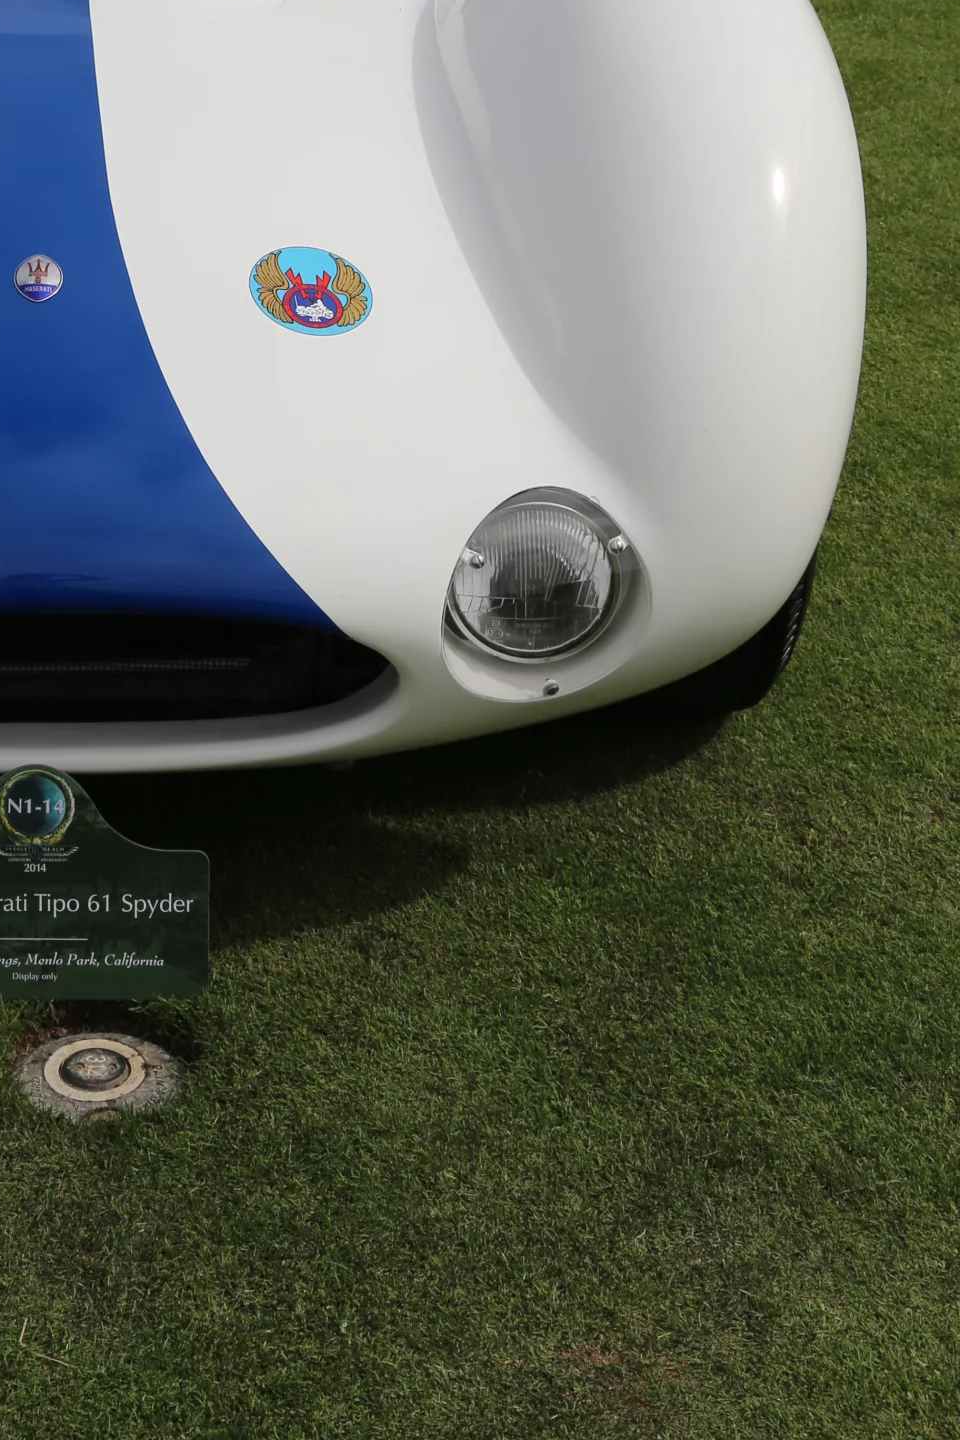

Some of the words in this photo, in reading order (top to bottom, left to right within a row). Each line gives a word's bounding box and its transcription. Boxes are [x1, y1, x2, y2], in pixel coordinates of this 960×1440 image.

[24, 285, 52, 293] MASERATI
[7, 797, 65, 815] N1-14
[23, 863, 47, 873] 2014
[33, 893, 80, 918] Tipo
[87, 893, 110, 913] 61
[121, 892, 194, 919] Spyder
[25, 952, 63, 966] Menlo
[66, 952, 100, 967] Park,
[104, 952, 165, 968] California
[12, 972, 39, 982] Display
[41, 972, 58, 982] only
